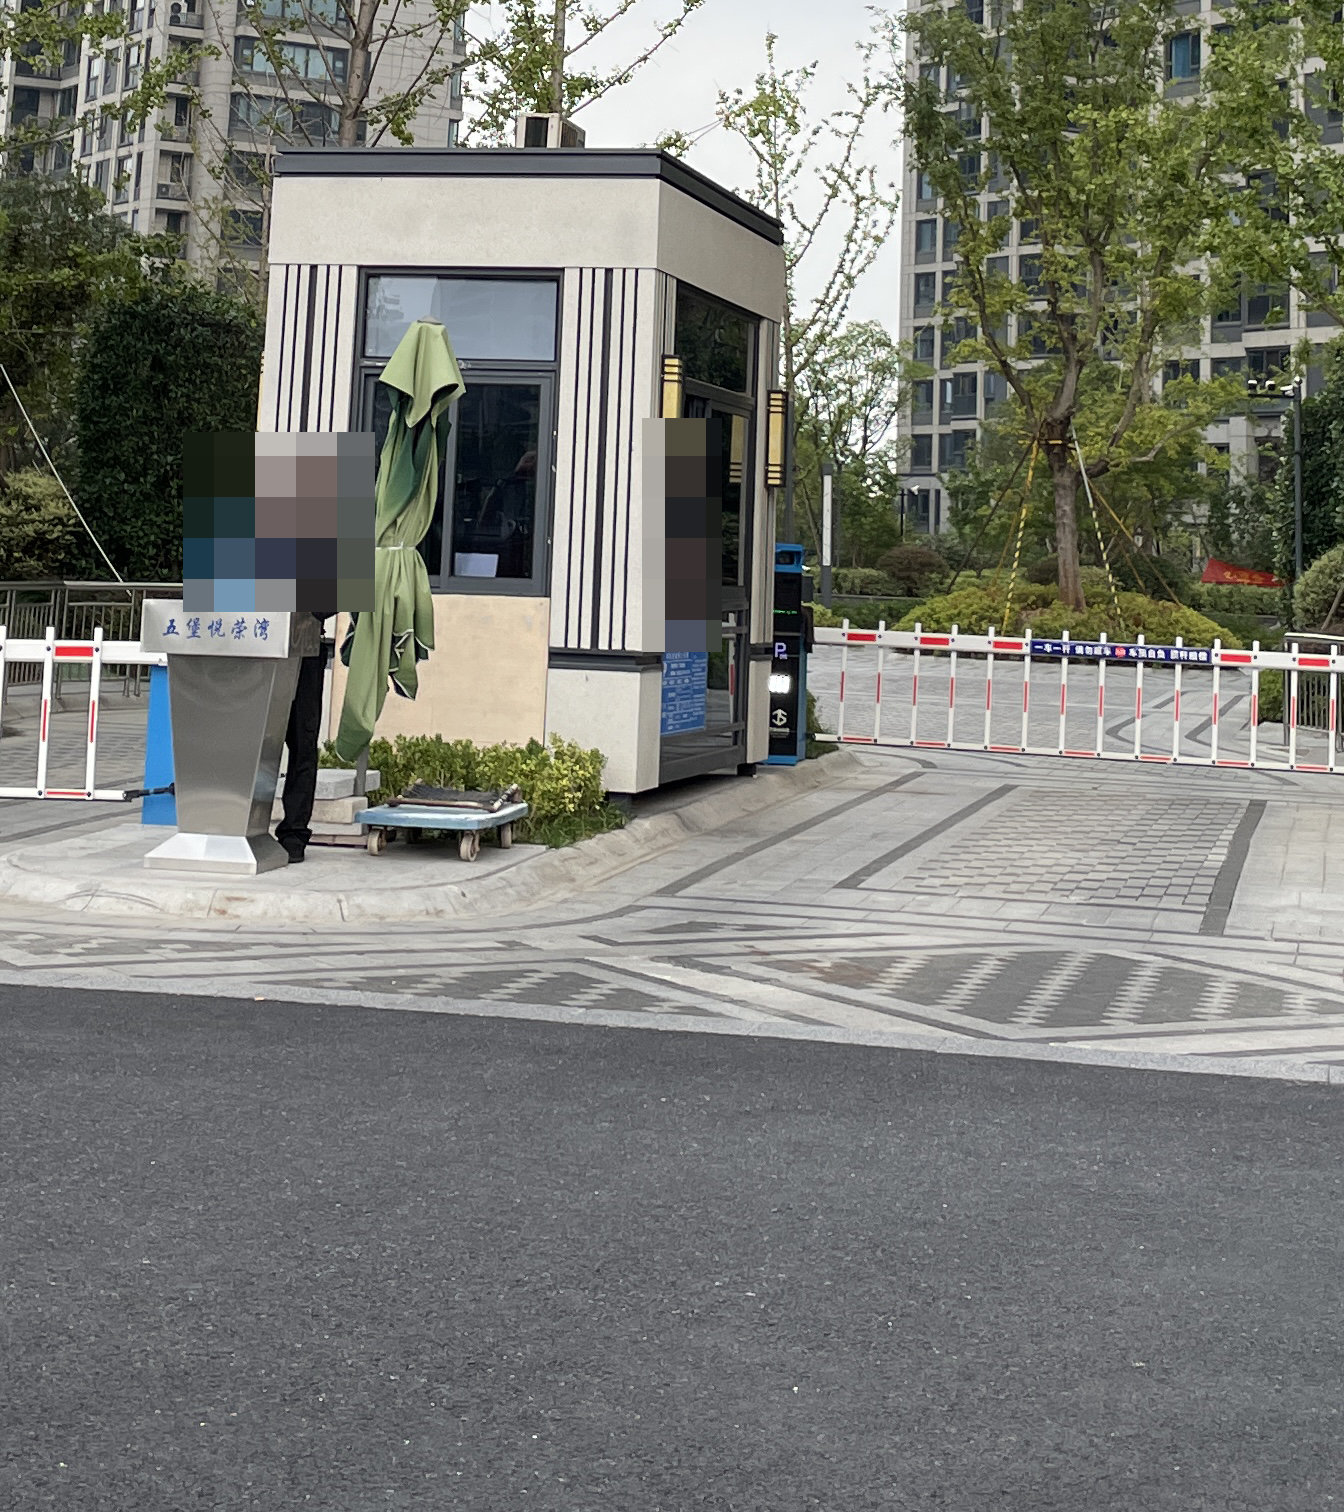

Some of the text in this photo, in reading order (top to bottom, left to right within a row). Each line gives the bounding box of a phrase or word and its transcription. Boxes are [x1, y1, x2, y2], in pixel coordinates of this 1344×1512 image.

[162, 616, 270, 641] 五堡悦荣湾
